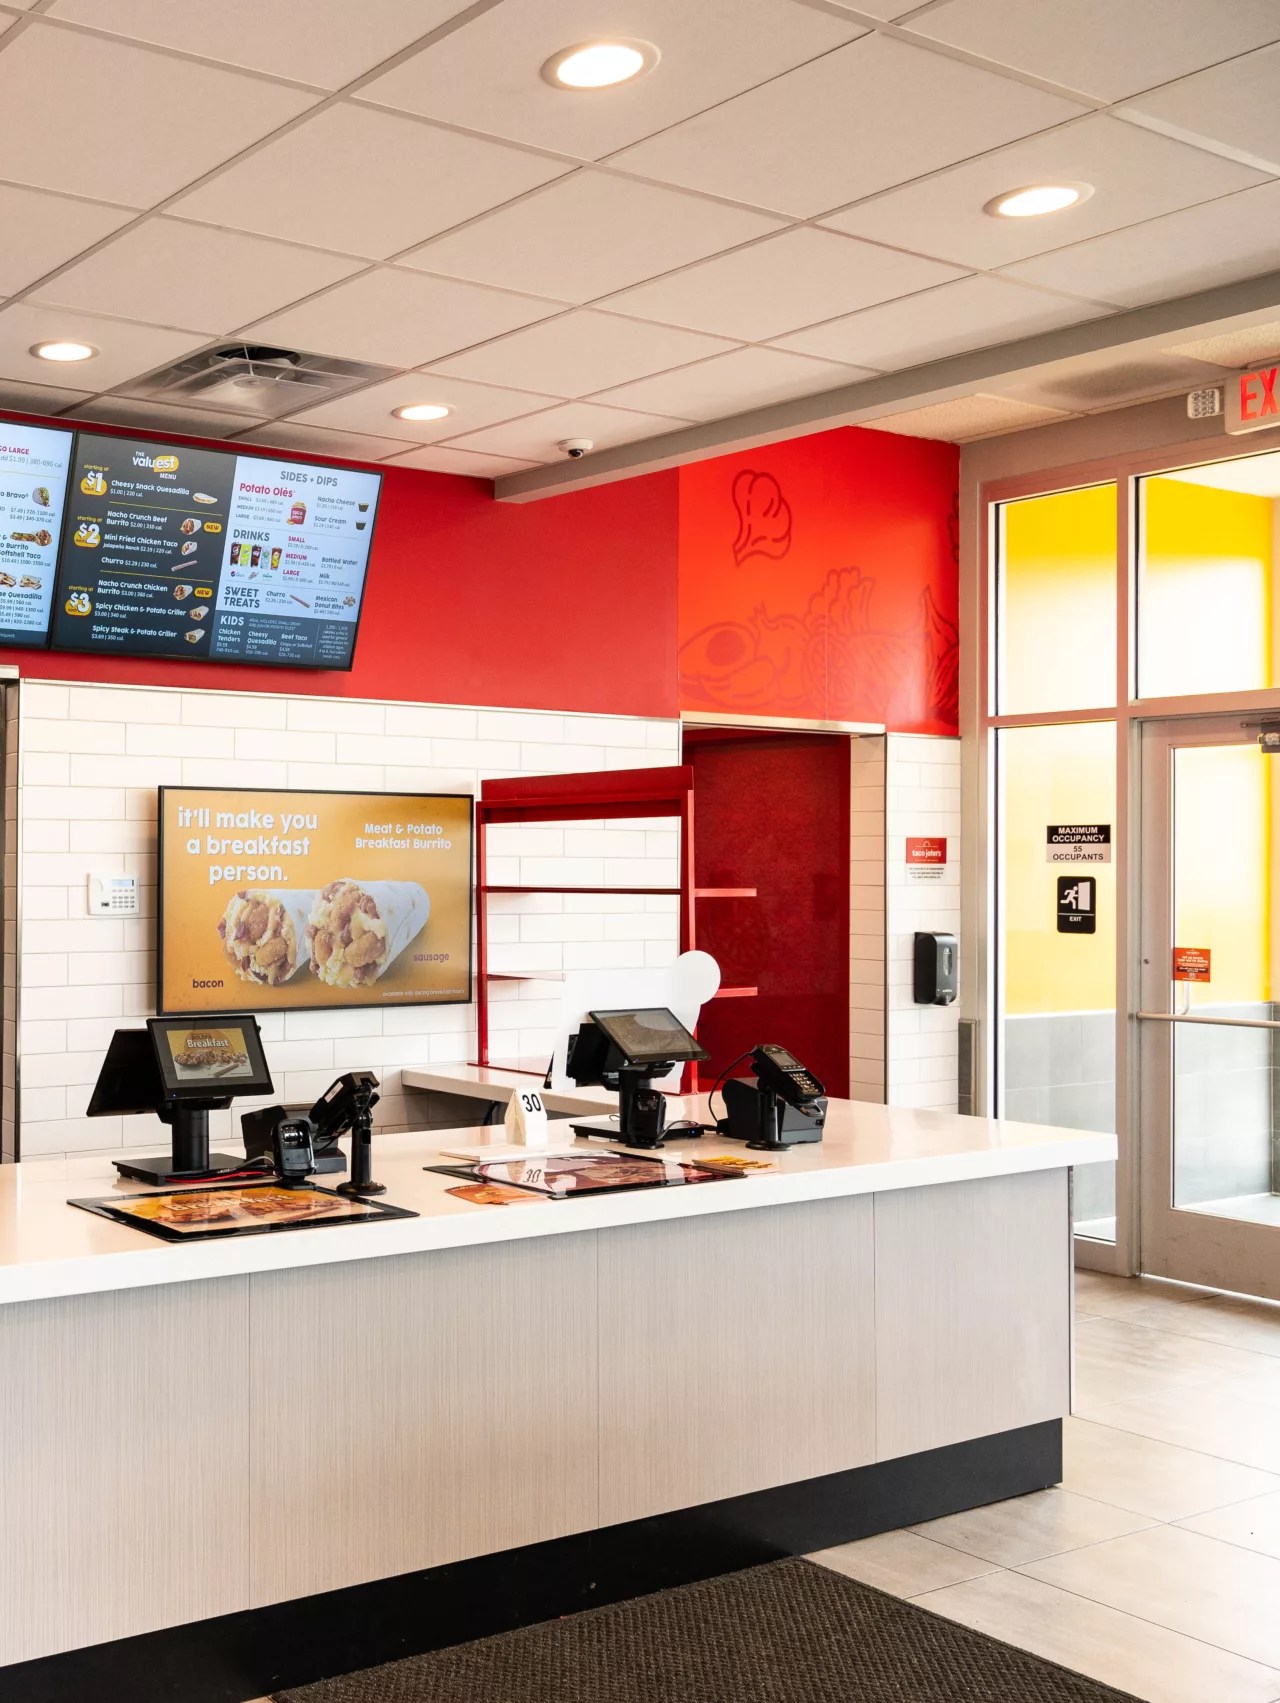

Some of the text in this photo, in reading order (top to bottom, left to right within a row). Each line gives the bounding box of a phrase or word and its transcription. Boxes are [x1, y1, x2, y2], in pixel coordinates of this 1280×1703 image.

[132, 455, 175, 469] valuest
[87, 471, 103, 492] $1
[280, 471, 307, 482] SIDES
[317, 474, 337, 486] DIPS
[112, 480, 134, 489] Cheesy
[157, 486, 190, 495] Quesadilla
[240, 483, 271, 495] Potato
[107, 510, 127, 519] Nacho
[129, 513, 151, 521] Crunch
[80, 523, 100, 543] $2
[233, 529, 269, 541] DRINKS
[6, 542, 28, 550] Burrito
[119, 535, 136, 543] Fried
[137, 537, 161, 545] Chicken
[120, 582, 142, 590] Crunch
[144, 584, 167, 592] Chicken
[225, 586, 259, 598] SWEET
[70, 592, 89, 612] $3
[95, 602, 112, 611] Spicy
[224, 596, 260, 608] TREATS
[220, 616, 244, 626] KIDS
[92, 625, 109, 633] Spicy
[178, 806, 319, 835] it'll make you
[365, 824, 443, 835] Meat & Potato
[187, 835, 310, 856] a breakfast
[356, 837, 451, 850] Breakfast Burrito
[209, 865, 288, 885] person.
[414, 953, 449, 962] sausage
[192, 978, 224, 989] bacon
[187, 1039, 229, 1048] Breakfast
[522, 1094, 541, 1112] 30
